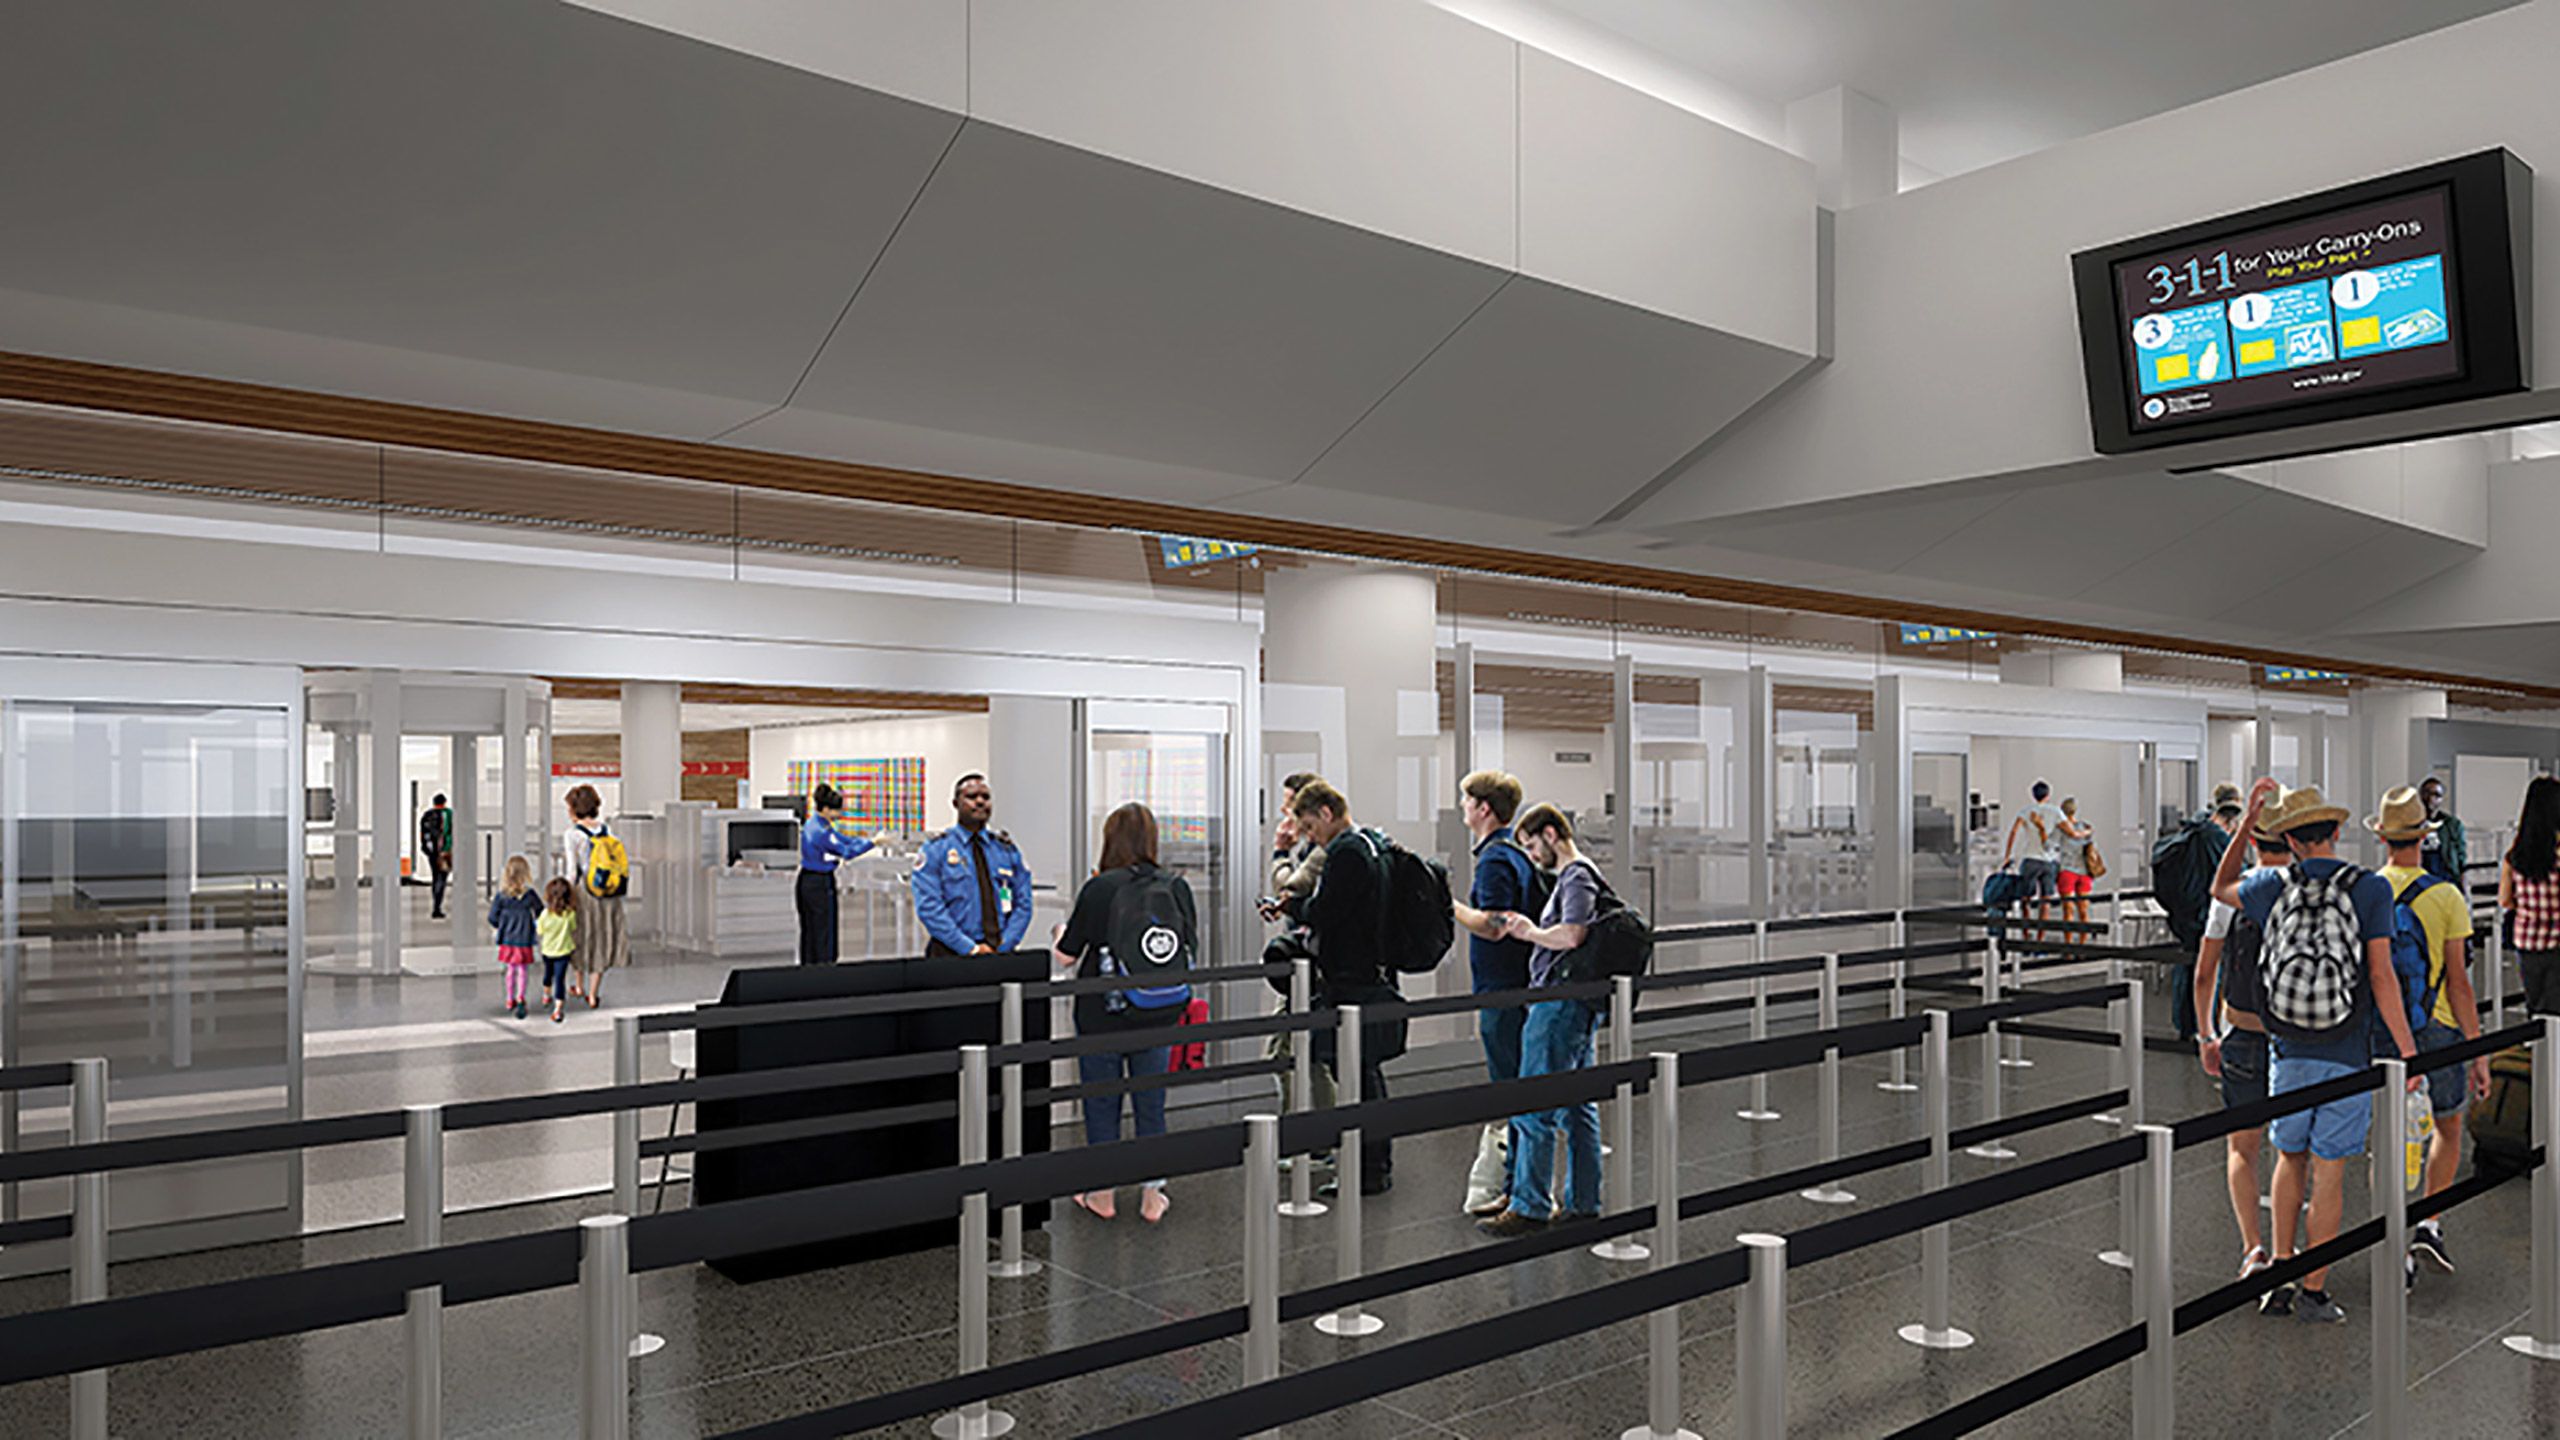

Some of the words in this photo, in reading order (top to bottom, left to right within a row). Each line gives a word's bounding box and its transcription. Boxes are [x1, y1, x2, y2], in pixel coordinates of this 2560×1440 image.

[2146, 251, 2236, 304] 3-1-1
[2234, 257, 2260, 273] for
[2266, 246, 2310, 266] Your
[2316, 221, 2422, 255] Carry-Ons
[2350, 277, 2360, 300] 1
[2245, 299, 2255, 322] 1
[2144, 318, 2162, 344] 3
